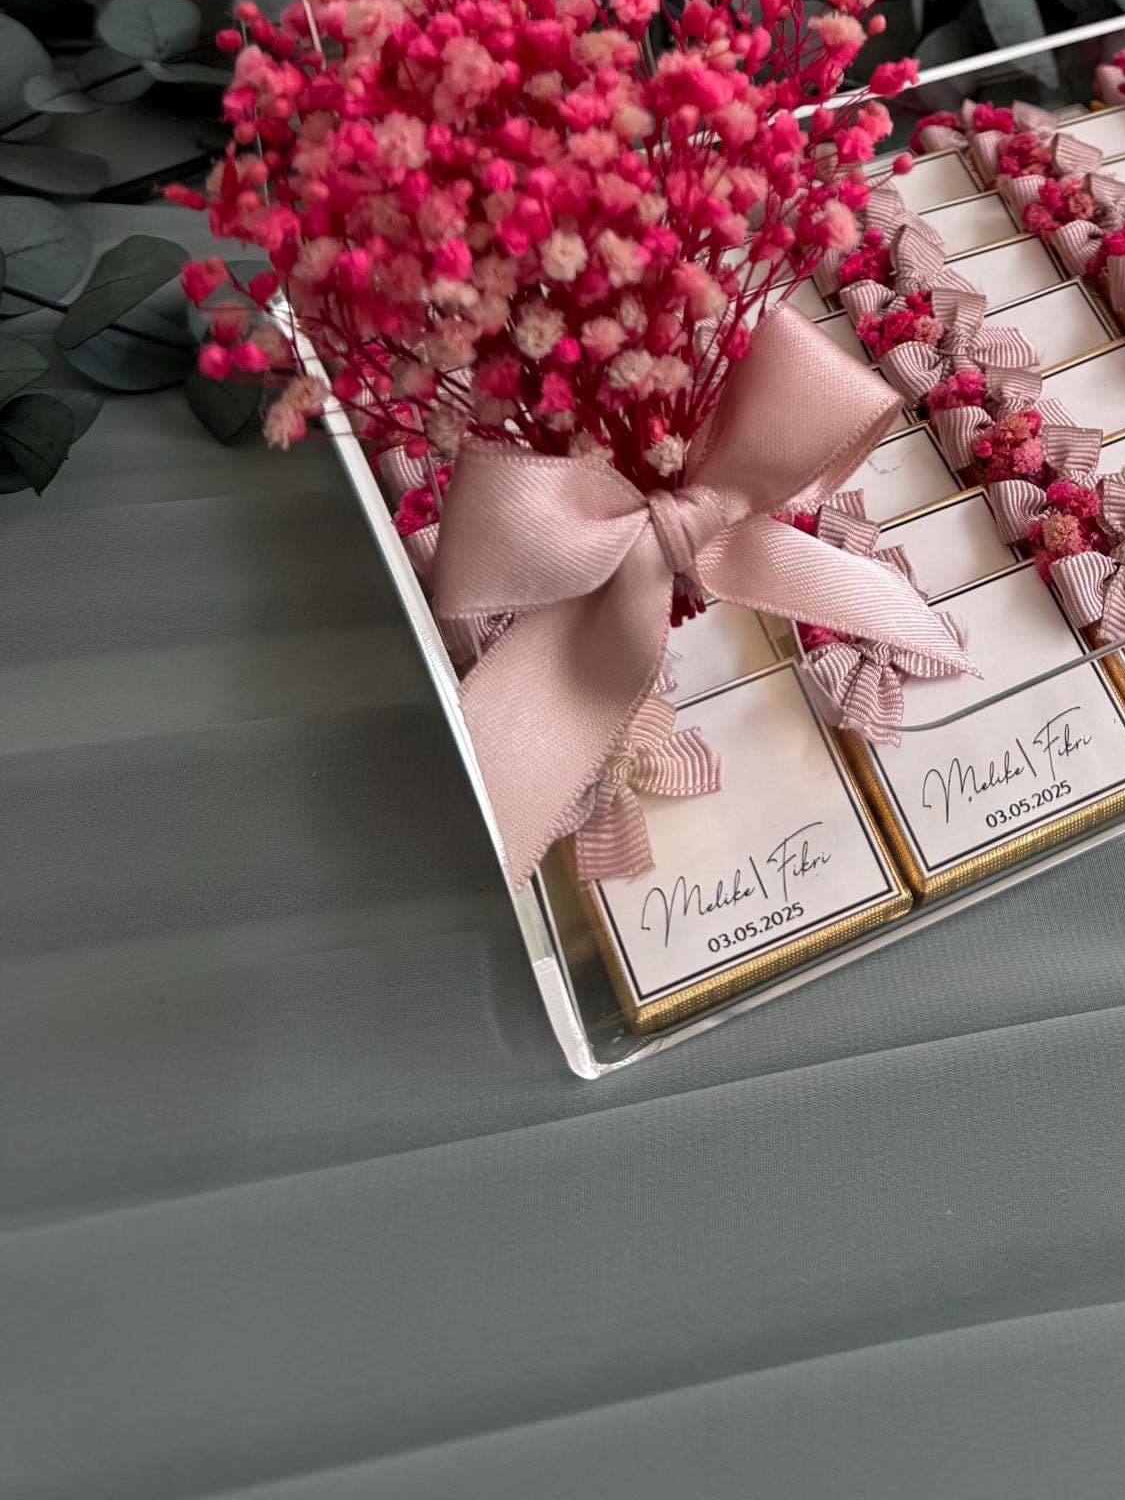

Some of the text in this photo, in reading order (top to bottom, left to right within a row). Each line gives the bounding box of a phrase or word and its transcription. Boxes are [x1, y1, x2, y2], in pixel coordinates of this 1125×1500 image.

[985, 779, 1072, 829] 03.05.2025
[640, 869, 755, 948] Melike
[766, 821, 832, 903] Fikri
[707, 901, 805, 953] 03.05.2025
